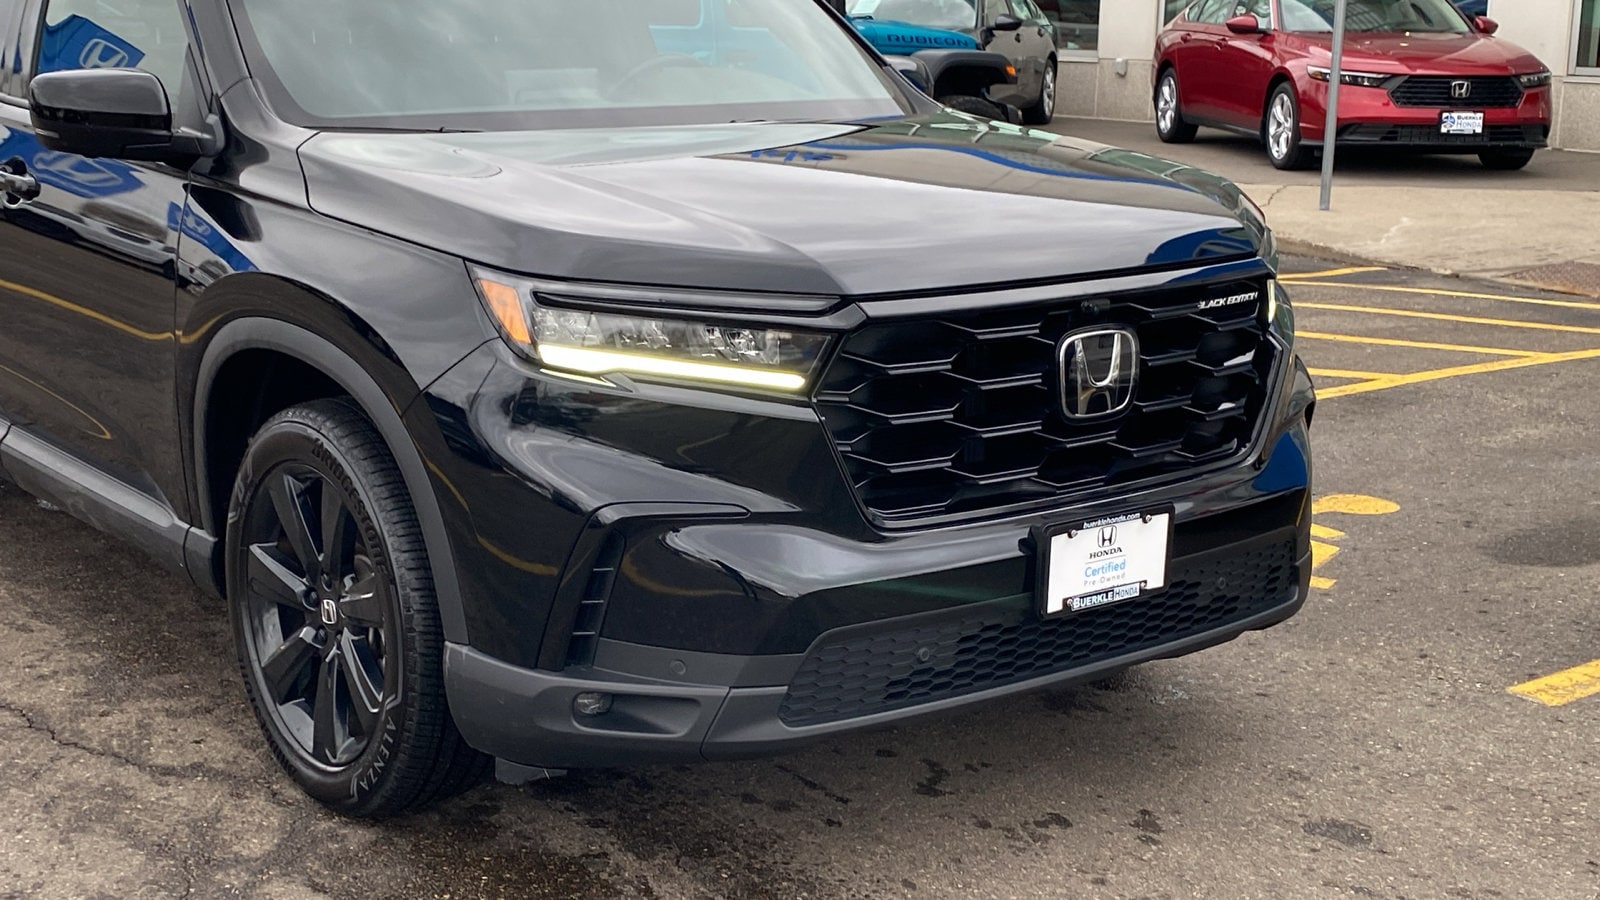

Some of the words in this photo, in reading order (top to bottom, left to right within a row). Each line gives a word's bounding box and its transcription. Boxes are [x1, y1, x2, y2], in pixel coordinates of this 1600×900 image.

[886, 34, 968, 47] RUBICON
[1456, 120, 1482, 129] HONDA
[1082, 512, 1141, 529] buerklehonda.com
[1089, 546, 1123, 559] HONDA
[1084, 559, 1127, 578] Certified
[1073, 590, 1114, 609] BUERKLE
[1114, 586, 1139, 600] HONDA
[360, 715, 396, 791] ALENZA
